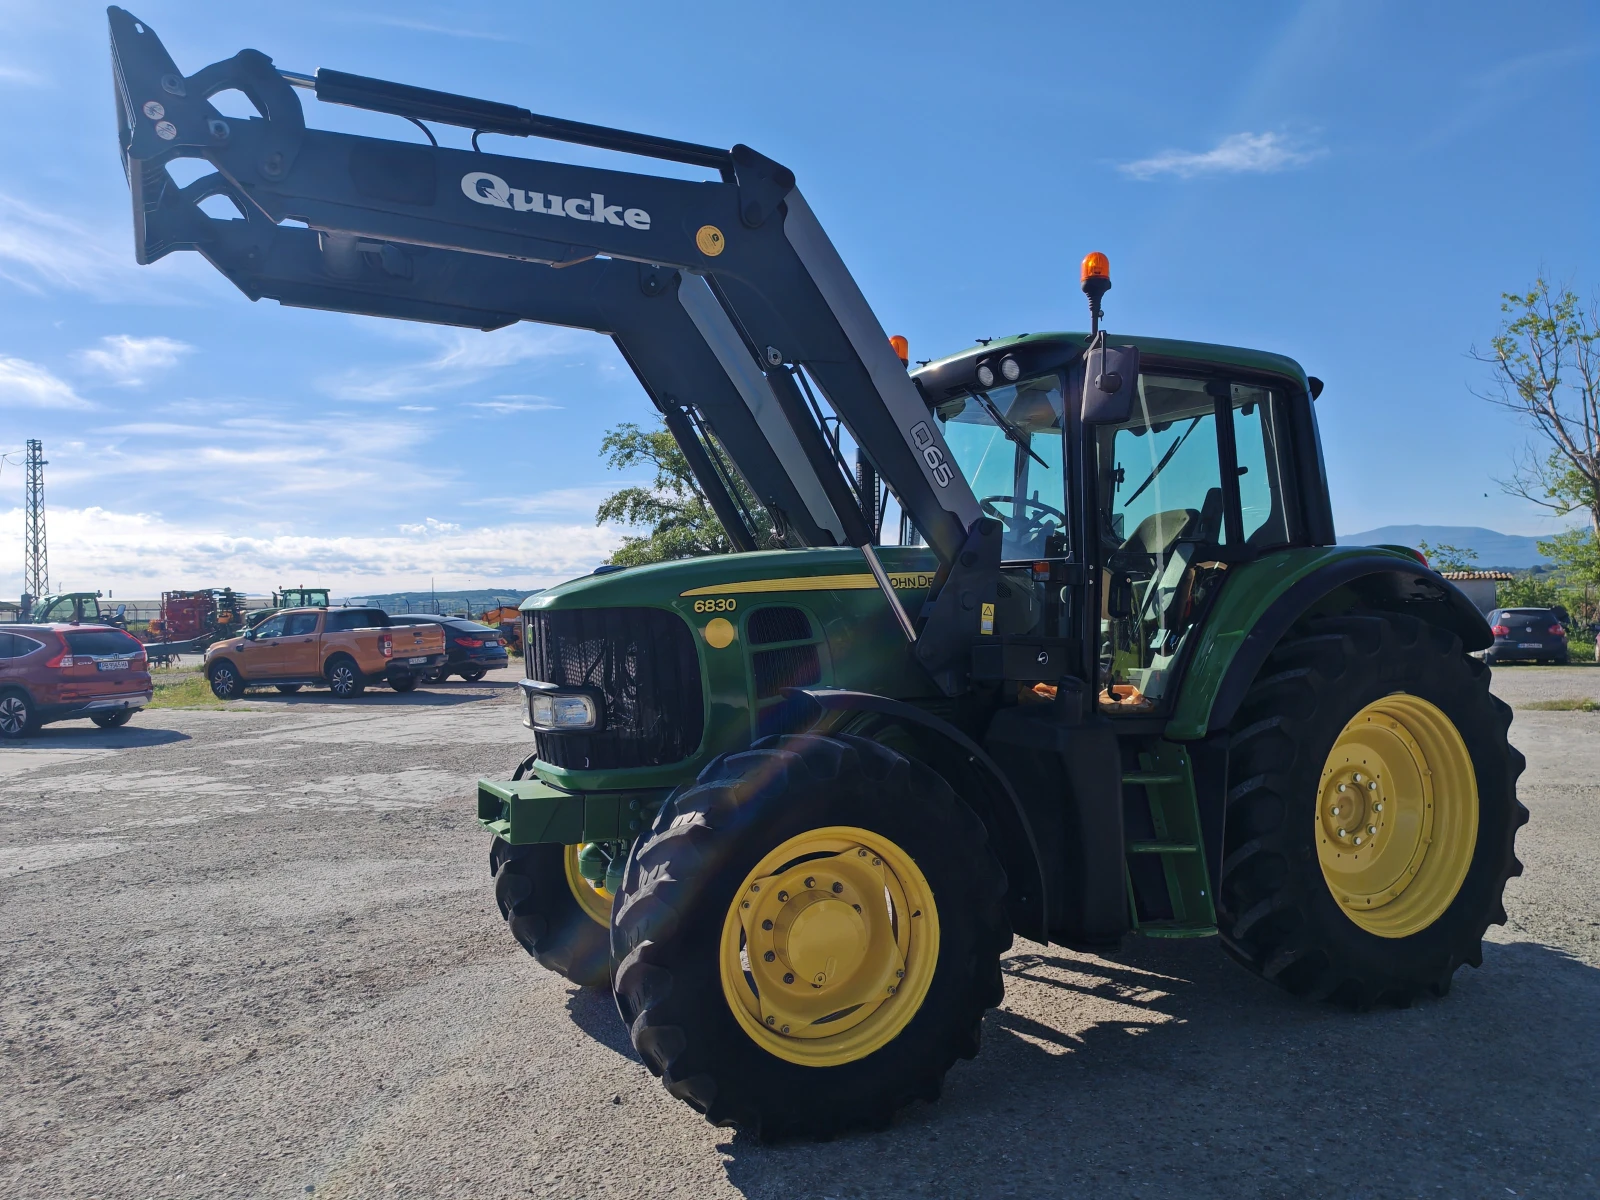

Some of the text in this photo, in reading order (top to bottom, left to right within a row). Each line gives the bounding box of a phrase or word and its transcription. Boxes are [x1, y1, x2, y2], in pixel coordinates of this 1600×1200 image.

[460, 171, 651, 230] Quicke
[909, 420, 955, 488] Q65
[889, 577, 916, 587] OHN
[693, 598, 737, 613] 6830
